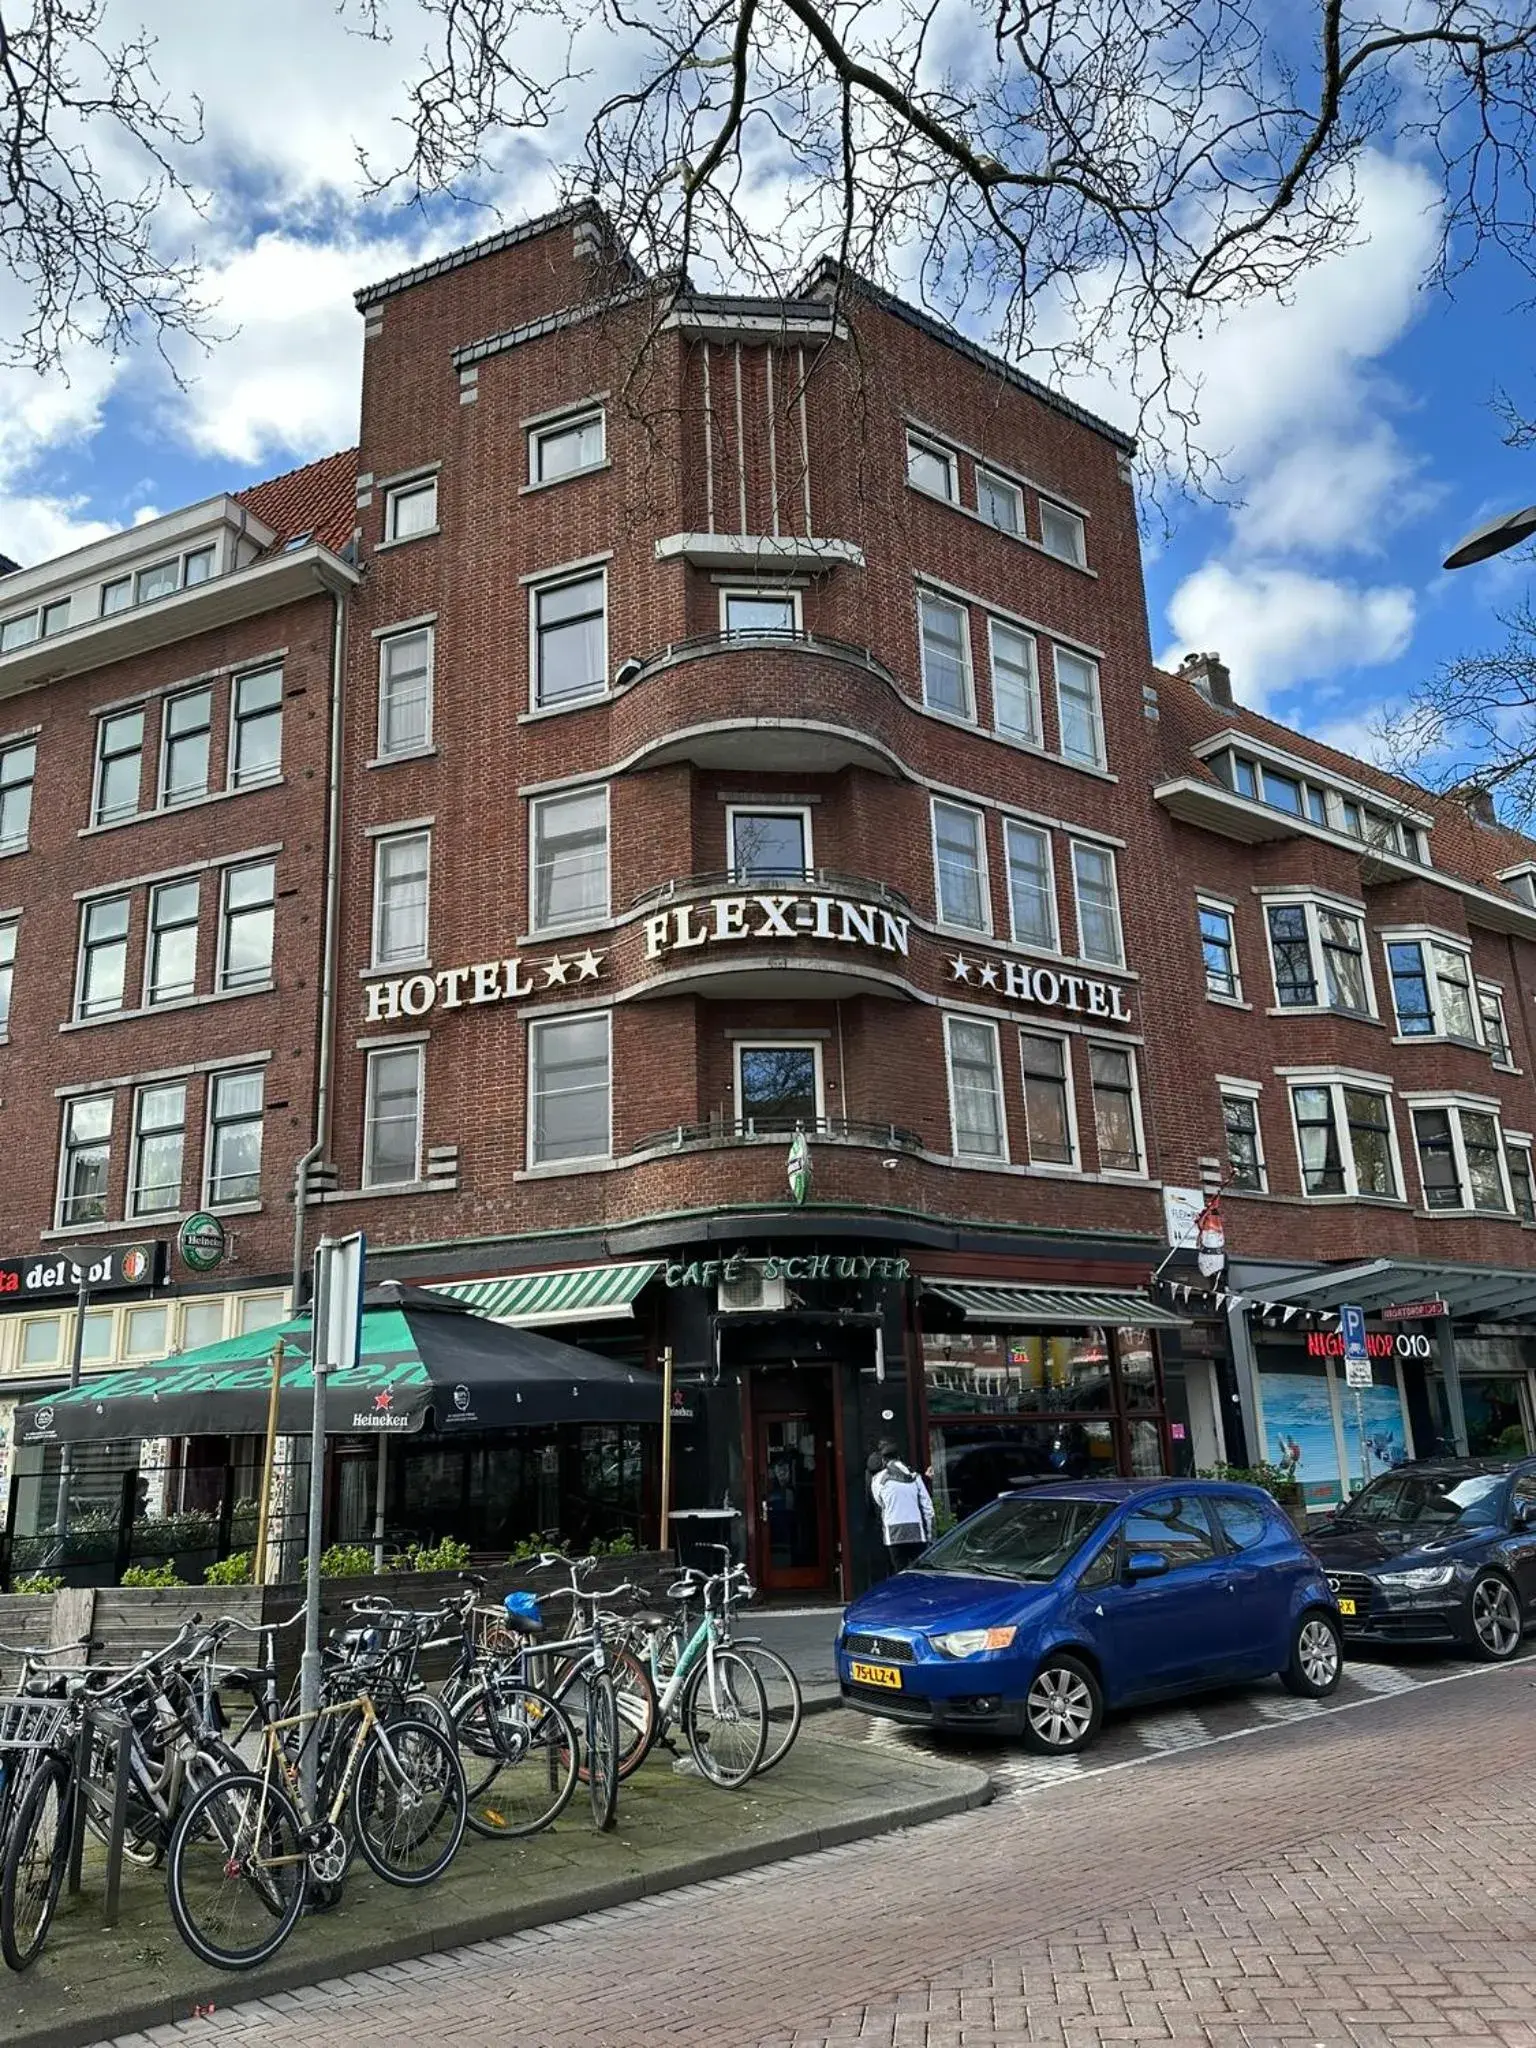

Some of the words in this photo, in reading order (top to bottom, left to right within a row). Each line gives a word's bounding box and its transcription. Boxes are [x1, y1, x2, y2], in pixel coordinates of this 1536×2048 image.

[643, 895, 910, 957] FLEX-INN
[365, 957, 533, 1022] HOTEL
[1002, 960, 1131, 1023] HOTEL
[26, 1261, 65, 1289] del
[765, 1256, 911, 1280] SCHUYER
[1347, 1310, 1359, 1337] P
[352, 1412, 409, 1426] Heineken
[855, 1664, 896, 1686] 75-LLZ-4
